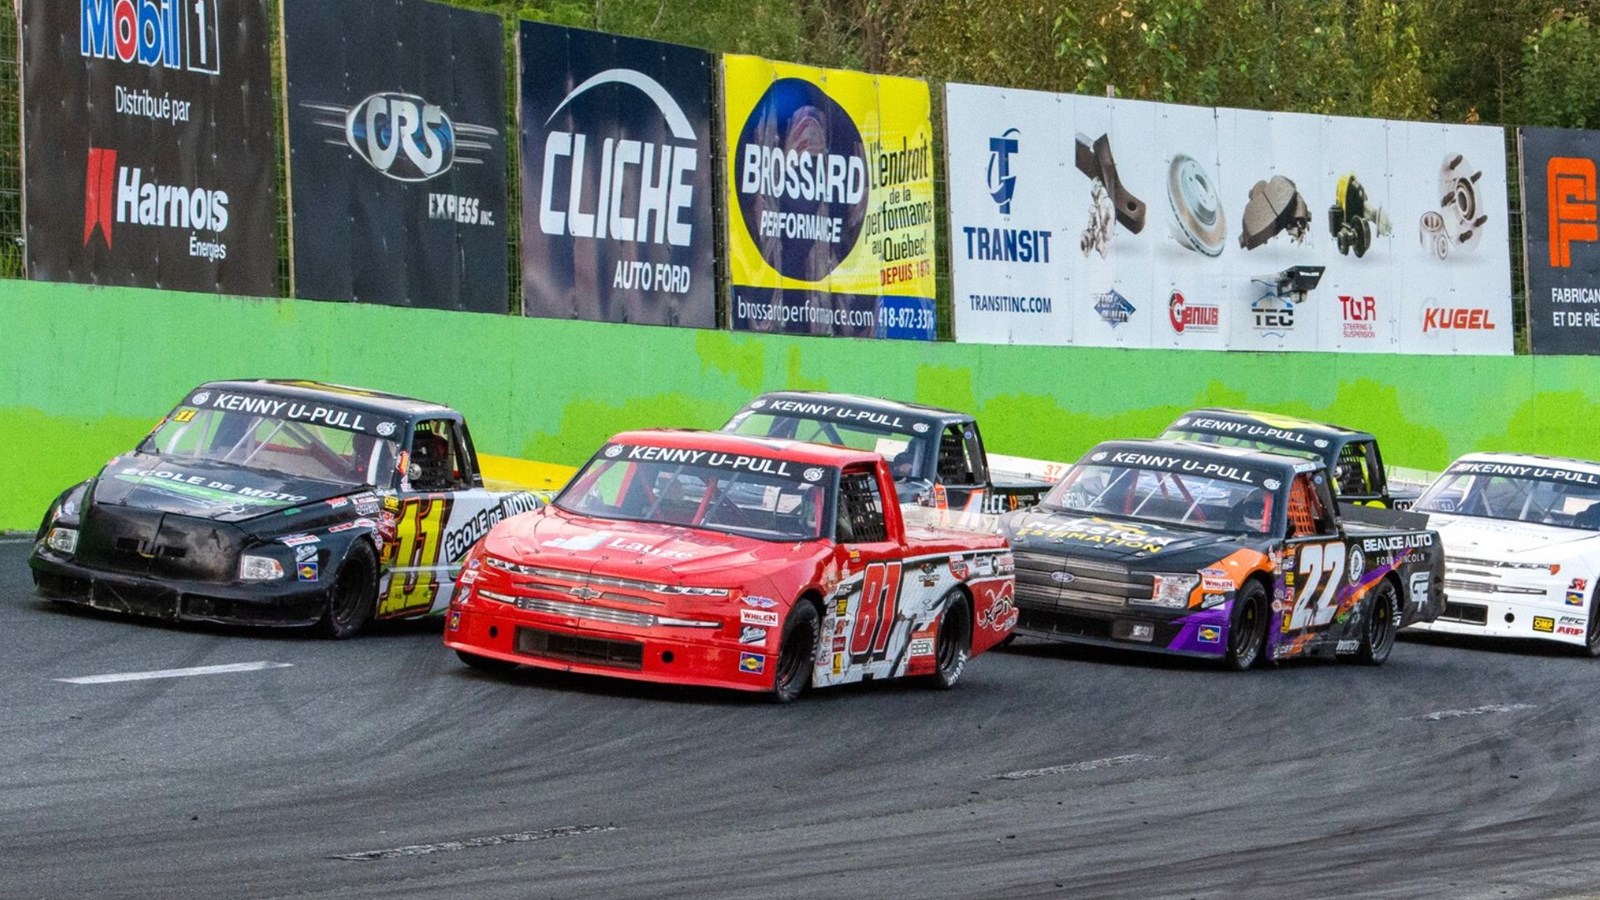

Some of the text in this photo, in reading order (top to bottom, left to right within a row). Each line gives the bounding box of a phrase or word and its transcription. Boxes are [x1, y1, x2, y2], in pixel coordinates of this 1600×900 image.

[80, 0, 181, 70] Mobil
[115, 85, 191, 123] Distribué par
[366, 96, 443, 175] CRS
[742, 143, 865, 206] BROSSARD
[870, 133, 929, 190] L'endroit
[117, 165, 229, 233] Harnois
[539, 130, 697, 247] CLICHE
[889, 185, 912, 204] de la
[760, 210, 842, 244] PERFORMANCE
[866, 201, 932, 244] performance
[190, 231, 227, 260] Énergies
[872, 239, 882, 256] au
[963, 226, 1052, 263] TRANSIT
[613, 260, 690, 294] AUTO FORD
[880, 264, 914, 287] DEPUIS
[969, 294, 1052, 314] TRANSITINC.COM
[1552, 287, 1600, 303] FABRICAN
[1252, 308, 1294, 326] TEC
[1423, 307, 1495, 332] KUGEL
[1553, 311, 1566, 327] ET
[1568, 311, 1583, 327] DE
[213, 393, 366, 431] KENNY U-PULL
[769, 399, 904, 428] KENNY U-PULL
[1191, 418, 1306, 444] KENNY U-PULL
[628, 445, 792, 477] KENNY U-PULL
[1111, 452, 1254, 482] KENNY U-PULL
[1470, 463, 1598, 485] KENNY U-PULL
[207, 480, 236, 492] DE
[238, 487, 308, 502] MOTO
[445, 491, 536, 562] ÉCOLE DE MOTO
[1016, 528, 1161, 553] ESTIMATION
[1026, 520, 1177, 546] MISSION
[1363, 533, 1433, 552] BEAUCE AUTO
[376, 497, 446, 618] 11
[1289, 541, 1346, 630] 22
[743, 611, 776, 623] WHELEN
[850, 562, 902, 655] 81
[1556, 626, 1584, 635] ARP
